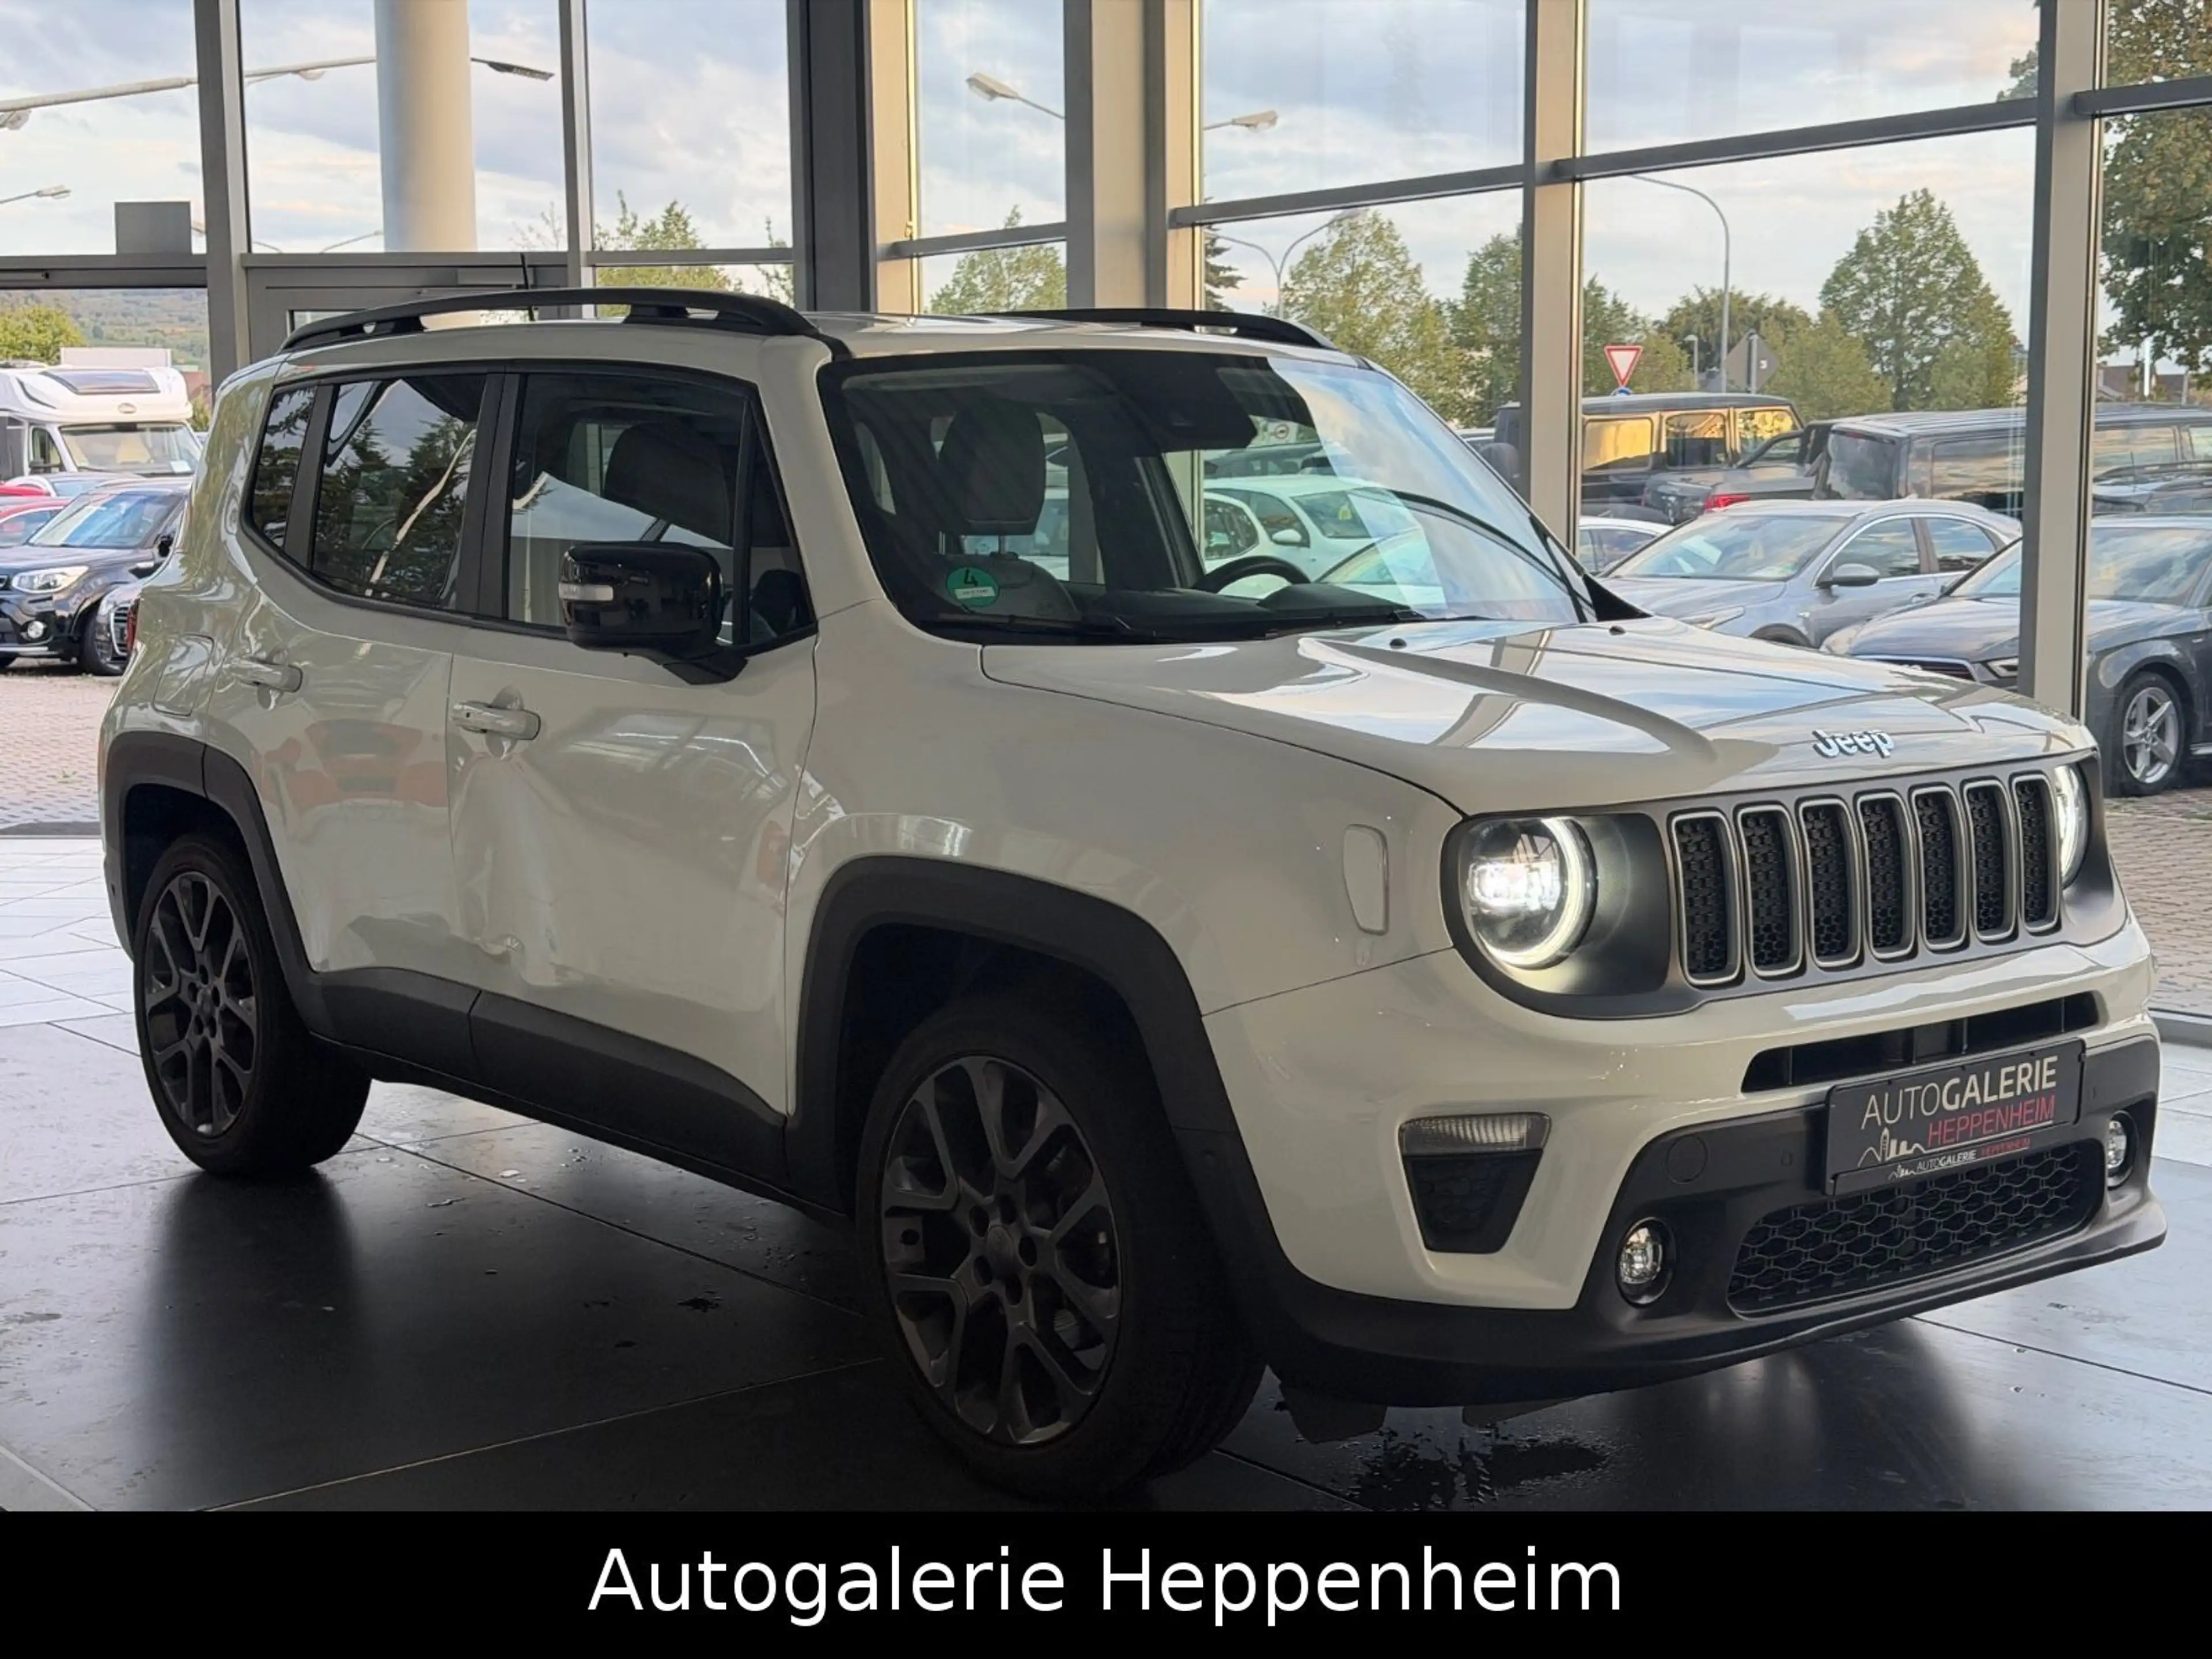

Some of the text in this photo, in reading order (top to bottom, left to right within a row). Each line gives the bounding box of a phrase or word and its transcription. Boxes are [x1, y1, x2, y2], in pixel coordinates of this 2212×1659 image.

[964, 569, 979, 586] 4
[1812, 729, 1894, 759] Jeep
[1861, 1055, 2058, 1130] AUTOGALERIE
[1928, 1094, 2055, 1147] HEPPENHEIM
[1916, 1149, 1977, 1172] AUTOGALERIE
